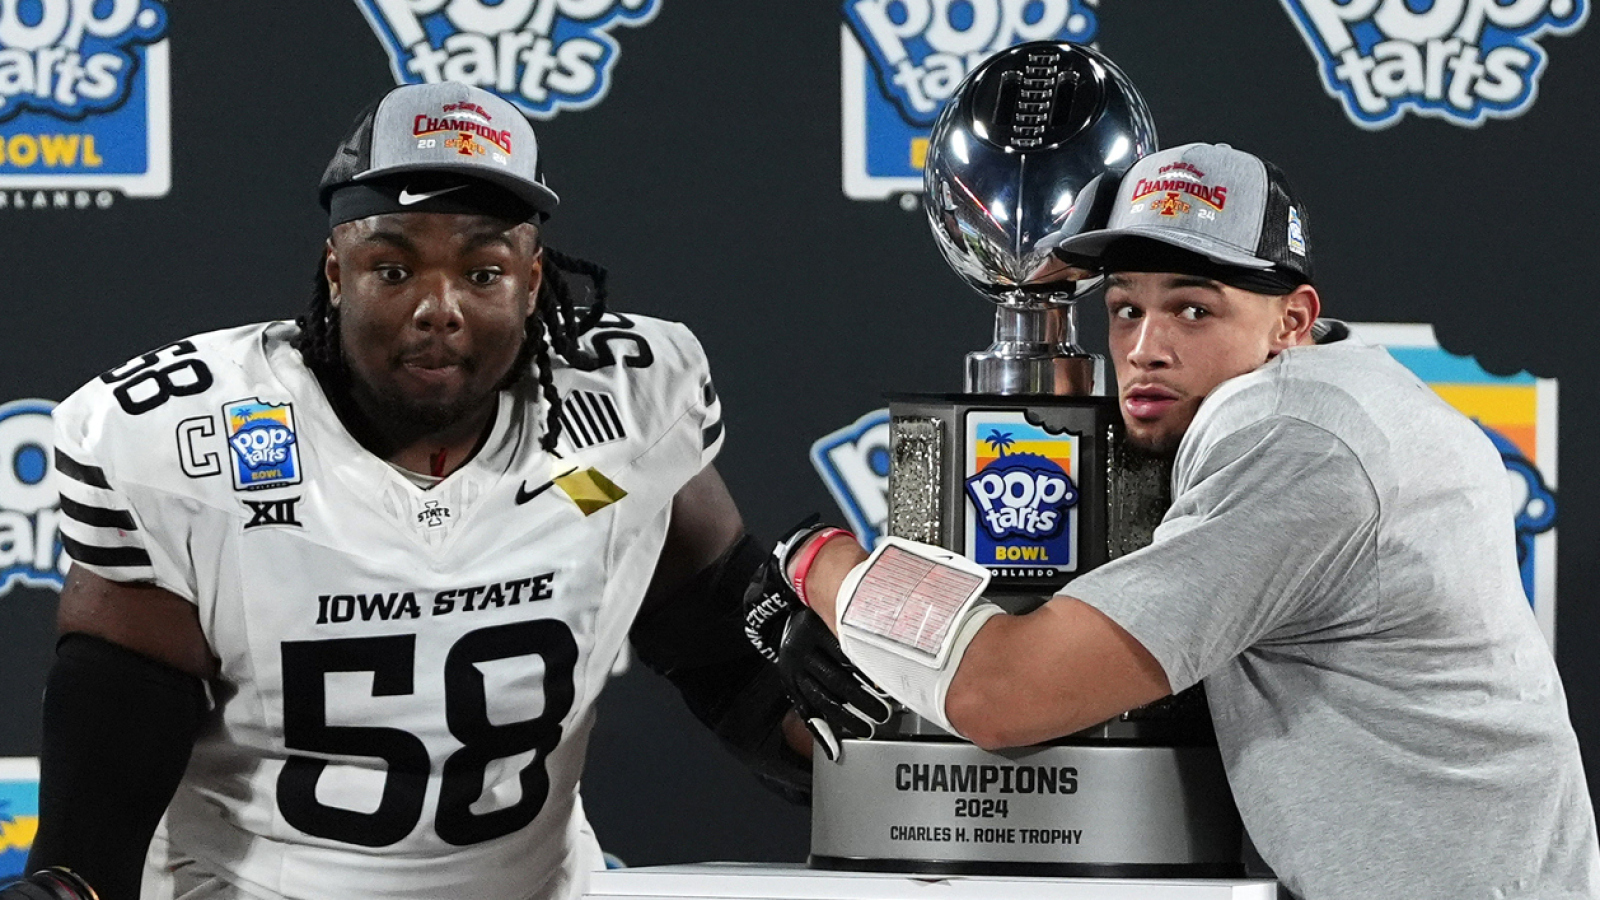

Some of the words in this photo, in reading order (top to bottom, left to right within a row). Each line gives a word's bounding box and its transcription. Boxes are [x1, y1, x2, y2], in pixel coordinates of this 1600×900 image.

[0, 48, 123, 106] arts
[407, 28, 601, 101] tarts
[1336, 37, 1530, 112] tarts
[413, 114, 511, 155] CHAMPIONS
[0, 134, 103, 168] OWL
[417, 139, 436, 149] 20
[492, 152, 507, 166] 24
[1130, 203, 1145, 214] 20
[1150, 199, 1191, 214] STATE
[1198, 208, 1216, 221] 24
[1131, 178, 1228, 212] CHAMPIONS
[176, 415, 222, 478] C
[246, 447, 287, 466] tarts
[251, 469, 283, 480] BOWL
[242, 495, 303, 529] XII
[417, 507, 451, 523] STATE
[986, 507, 1057, 534] tarts
[995, 546, 1048, 561] BOWL
[316, 592, 421, 625] IOWA
[432, 571, 554, 616] STATE
[276, 617, 579, 847] 58
[895, 763, 1079, 794] CHAMPIONS
[954, 798, 1009, 818] 2024
[890, 825, 951, 842] CHARLES
[955, 827, 969, 843] H.
[974, 828, 1015, 844] ROHE
[1019, 829, 1083, 844] TROPHY
